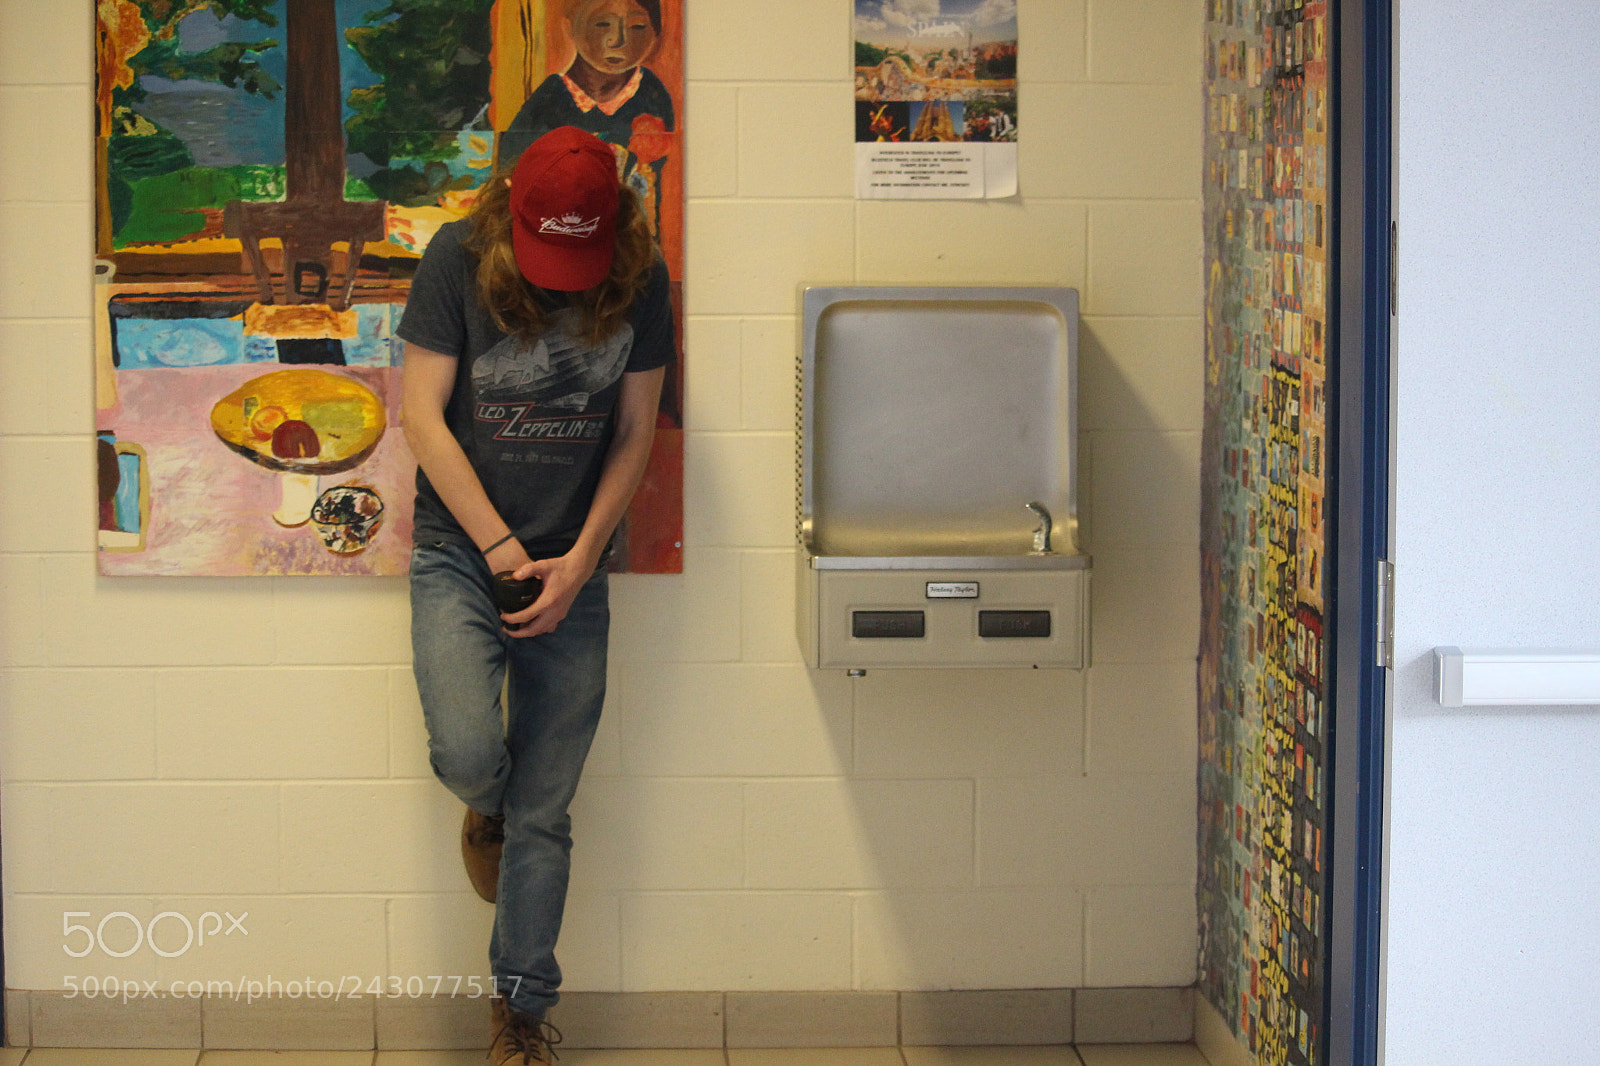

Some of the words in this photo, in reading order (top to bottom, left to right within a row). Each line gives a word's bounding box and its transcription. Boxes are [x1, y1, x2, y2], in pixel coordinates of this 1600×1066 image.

[906, 21, 966, 38] SPAIN
[478, 406, 506, 419] LED
[502, 406, 587, 437] ZEPPELIN
